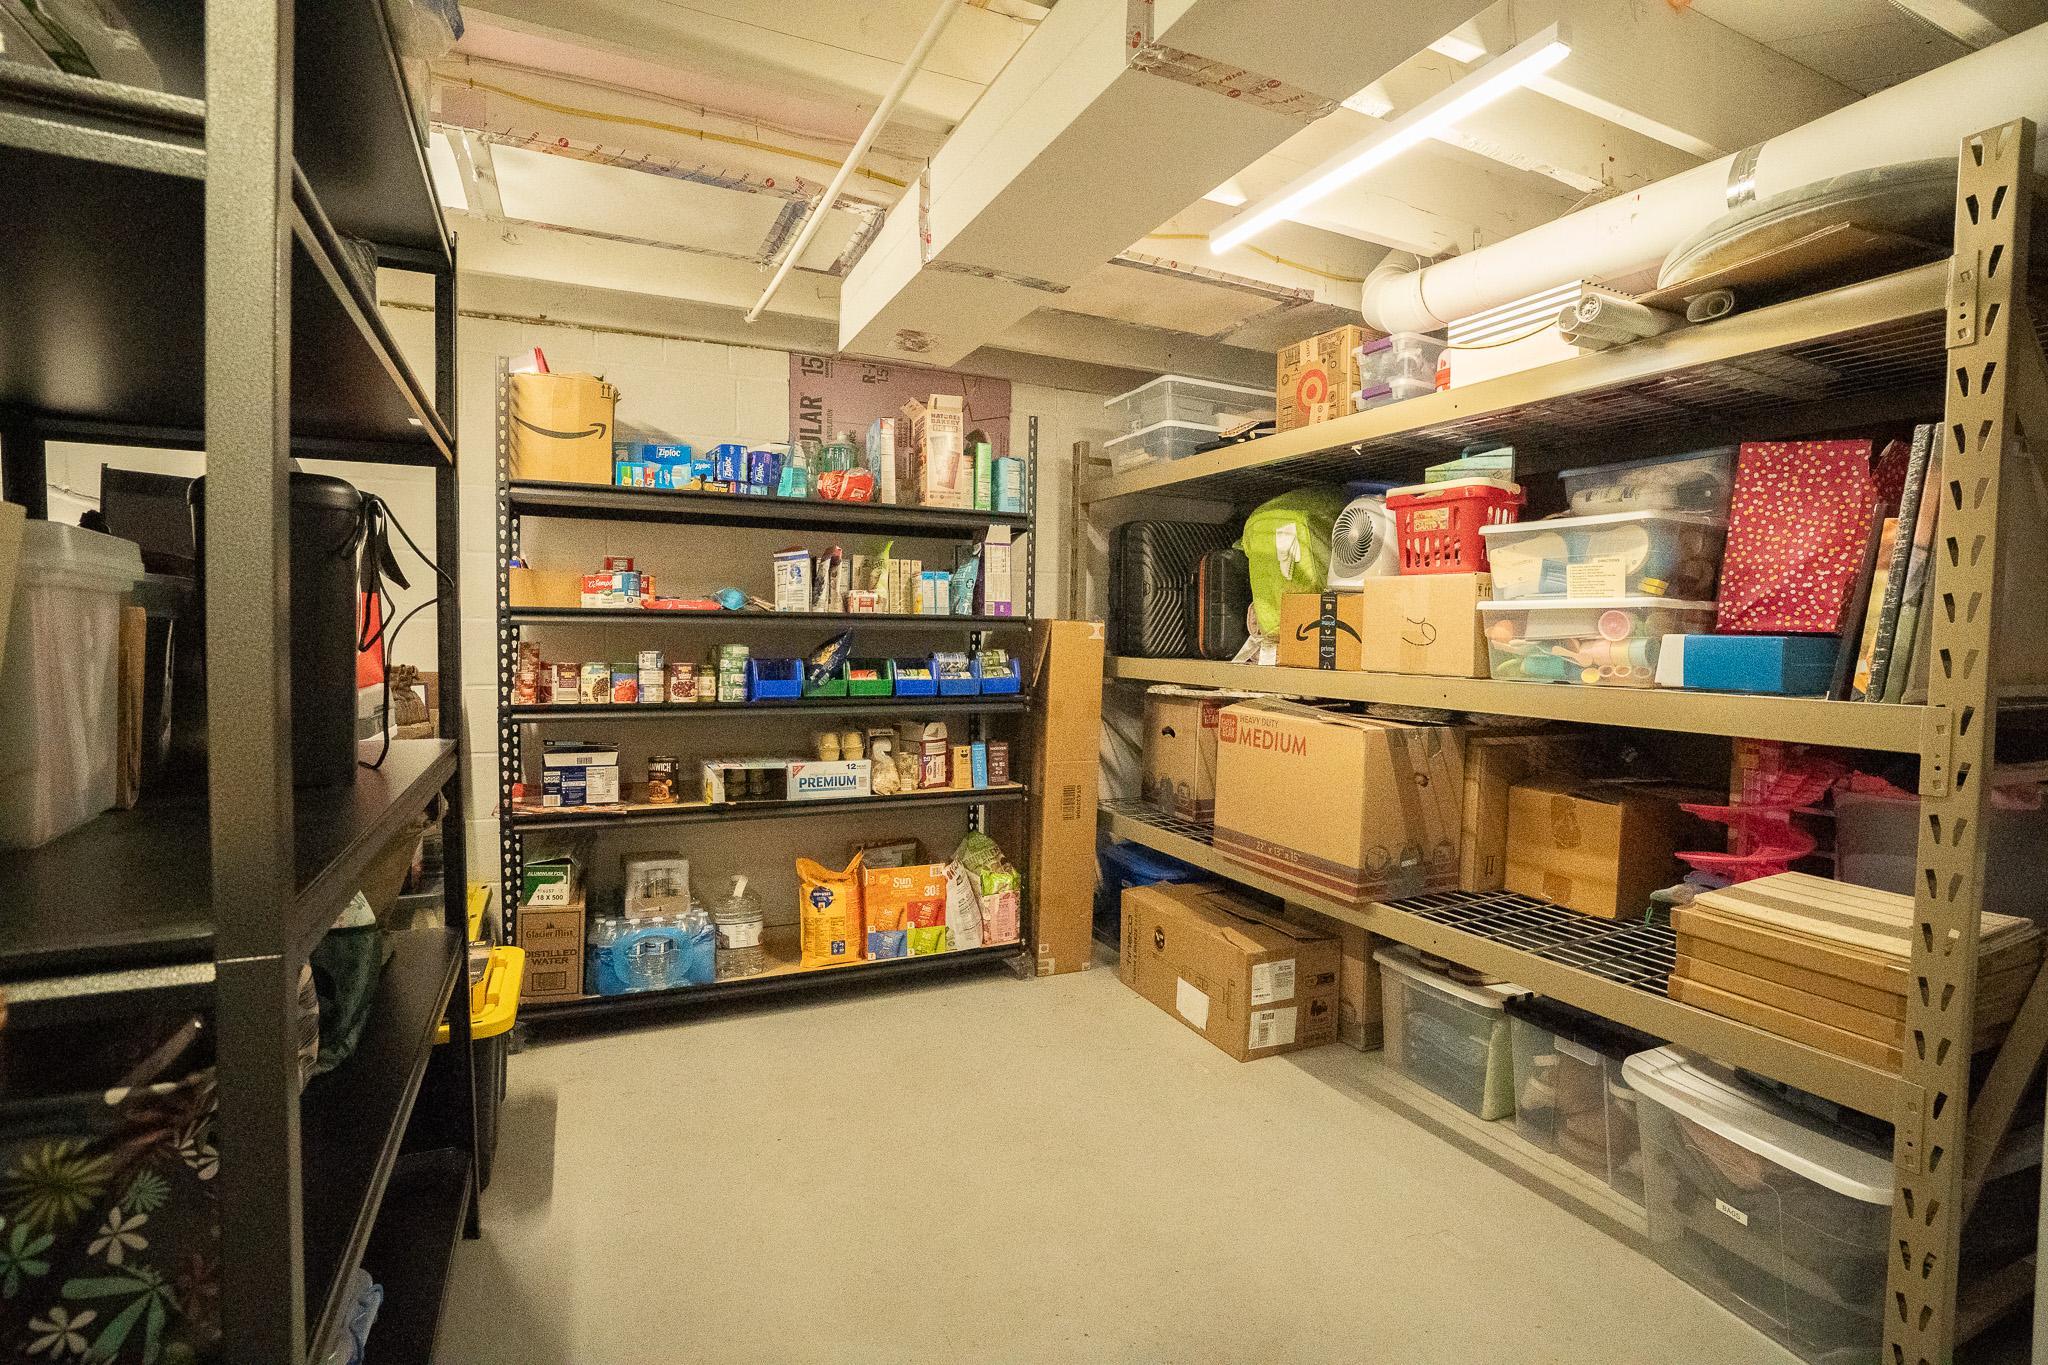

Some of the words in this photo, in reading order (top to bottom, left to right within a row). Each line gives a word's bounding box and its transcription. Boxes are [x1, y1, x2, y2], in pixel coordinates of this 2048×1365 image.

[657, 448, 681, 458] Ziploc
[724, 456, 734, 478] Ziploc
[755, 462, 765, 483] Ziploc
[1239, 714, 1261, 725] HEAVY
[1262, 717, 1279, 727] DUTY
[1239, 727, 1307, 757] MEDIUM
[799, 775, 857, 788] PREMIUM
[893, 876, 912, 888] Sun
[924, 885, 936, 897] 30
[525, 929, 553, 939] Glacier
[554, 929, 574, 938] Mist
[525, 948, 578, 958] DISTILLED
[530, 957, 569, 966] WATER
[1722, 1204, 1741, 1220] BAGS
